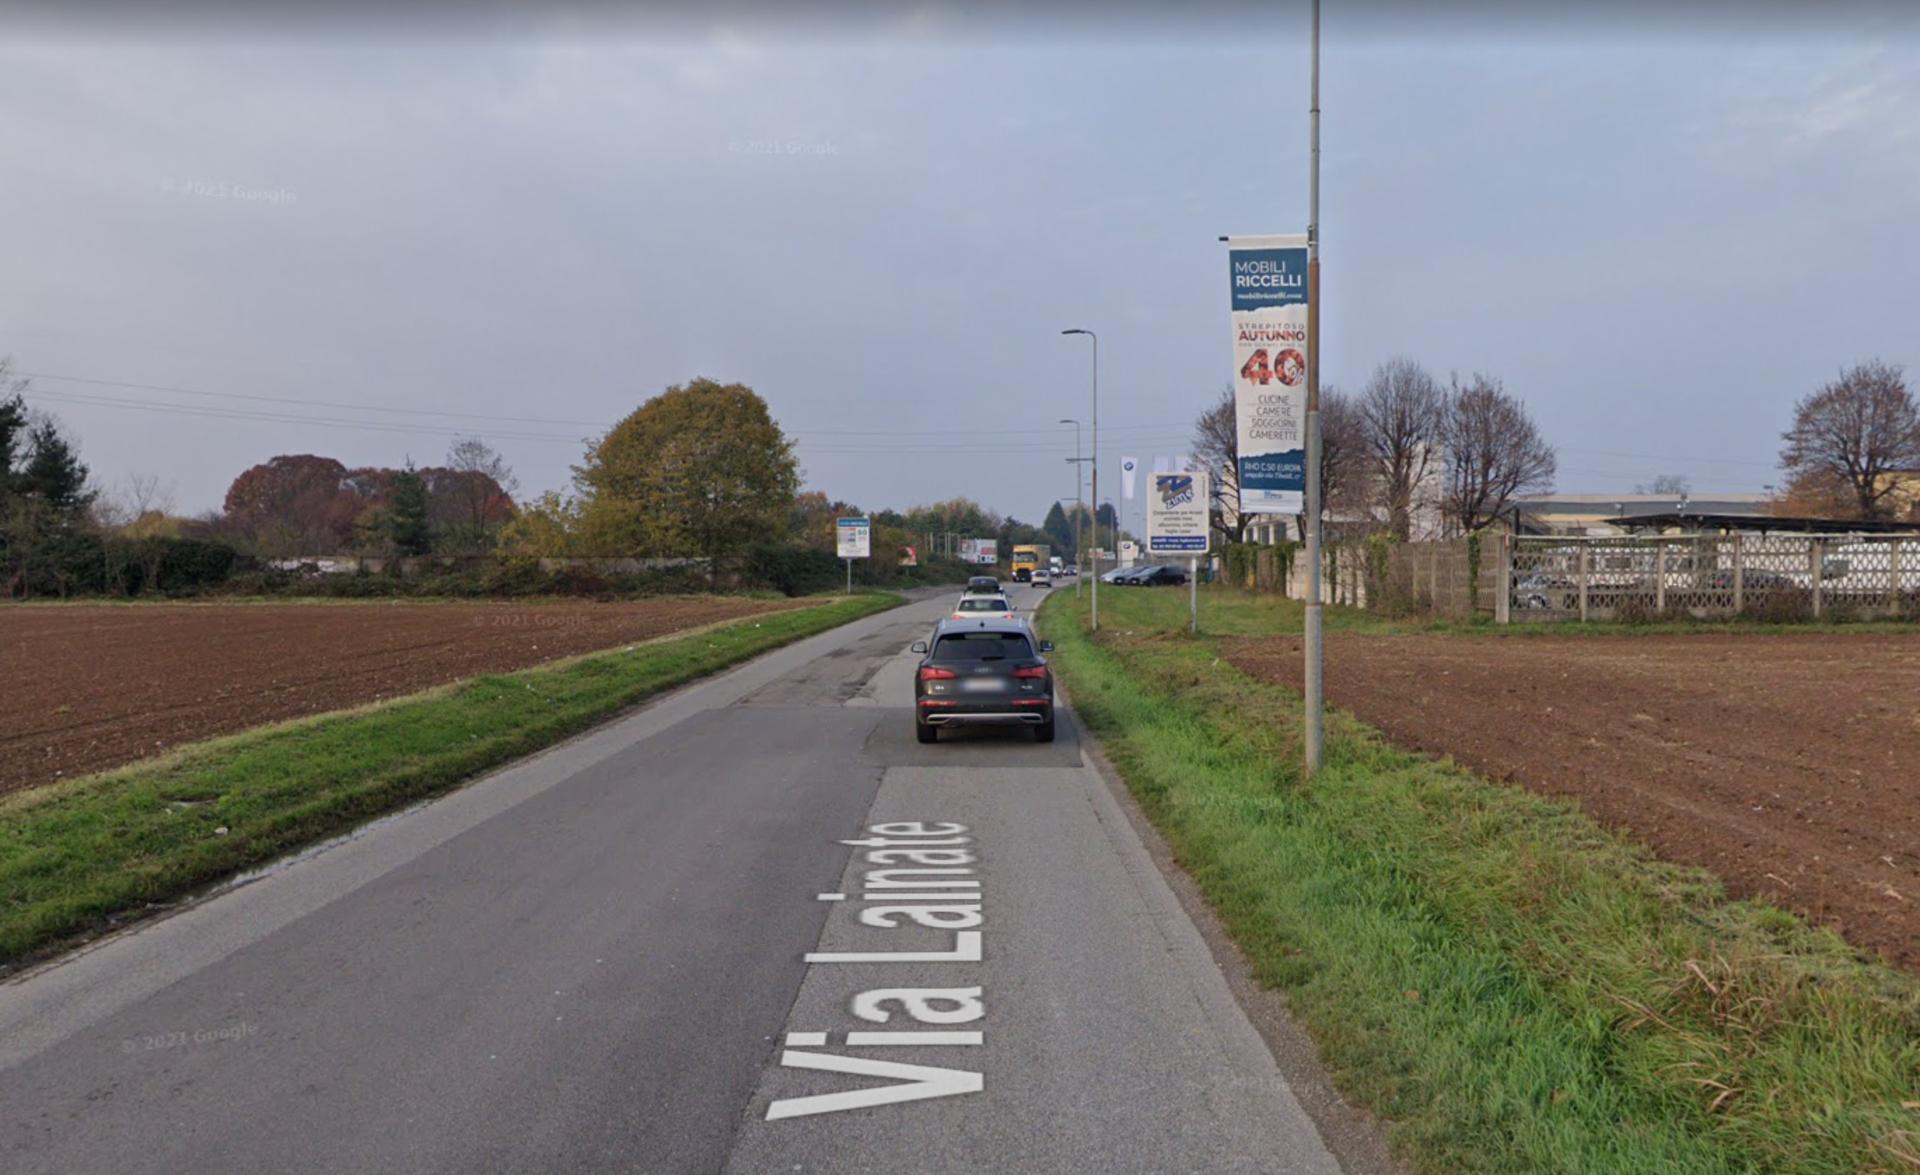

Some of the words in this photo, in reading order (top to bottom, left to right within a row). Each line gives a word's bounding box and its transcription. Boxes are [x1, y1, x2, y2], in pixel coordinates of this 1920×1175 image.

[1235, 260, 1286, 274] MOBILI
[1236, 274, 1302, 288] RICCELLI
[1238, 322, 1305, 330] STREPITOSO
[1239, 330, 1305, 342] AUTUNNO
[1258, 395, 1289, 405] CUCINE
[1256, 406, 1291, 417] CAMERE
[1251, 418, 1297, 429] SOGGIORNI
[1249, 430, 1297, 441] CAMERETTE
